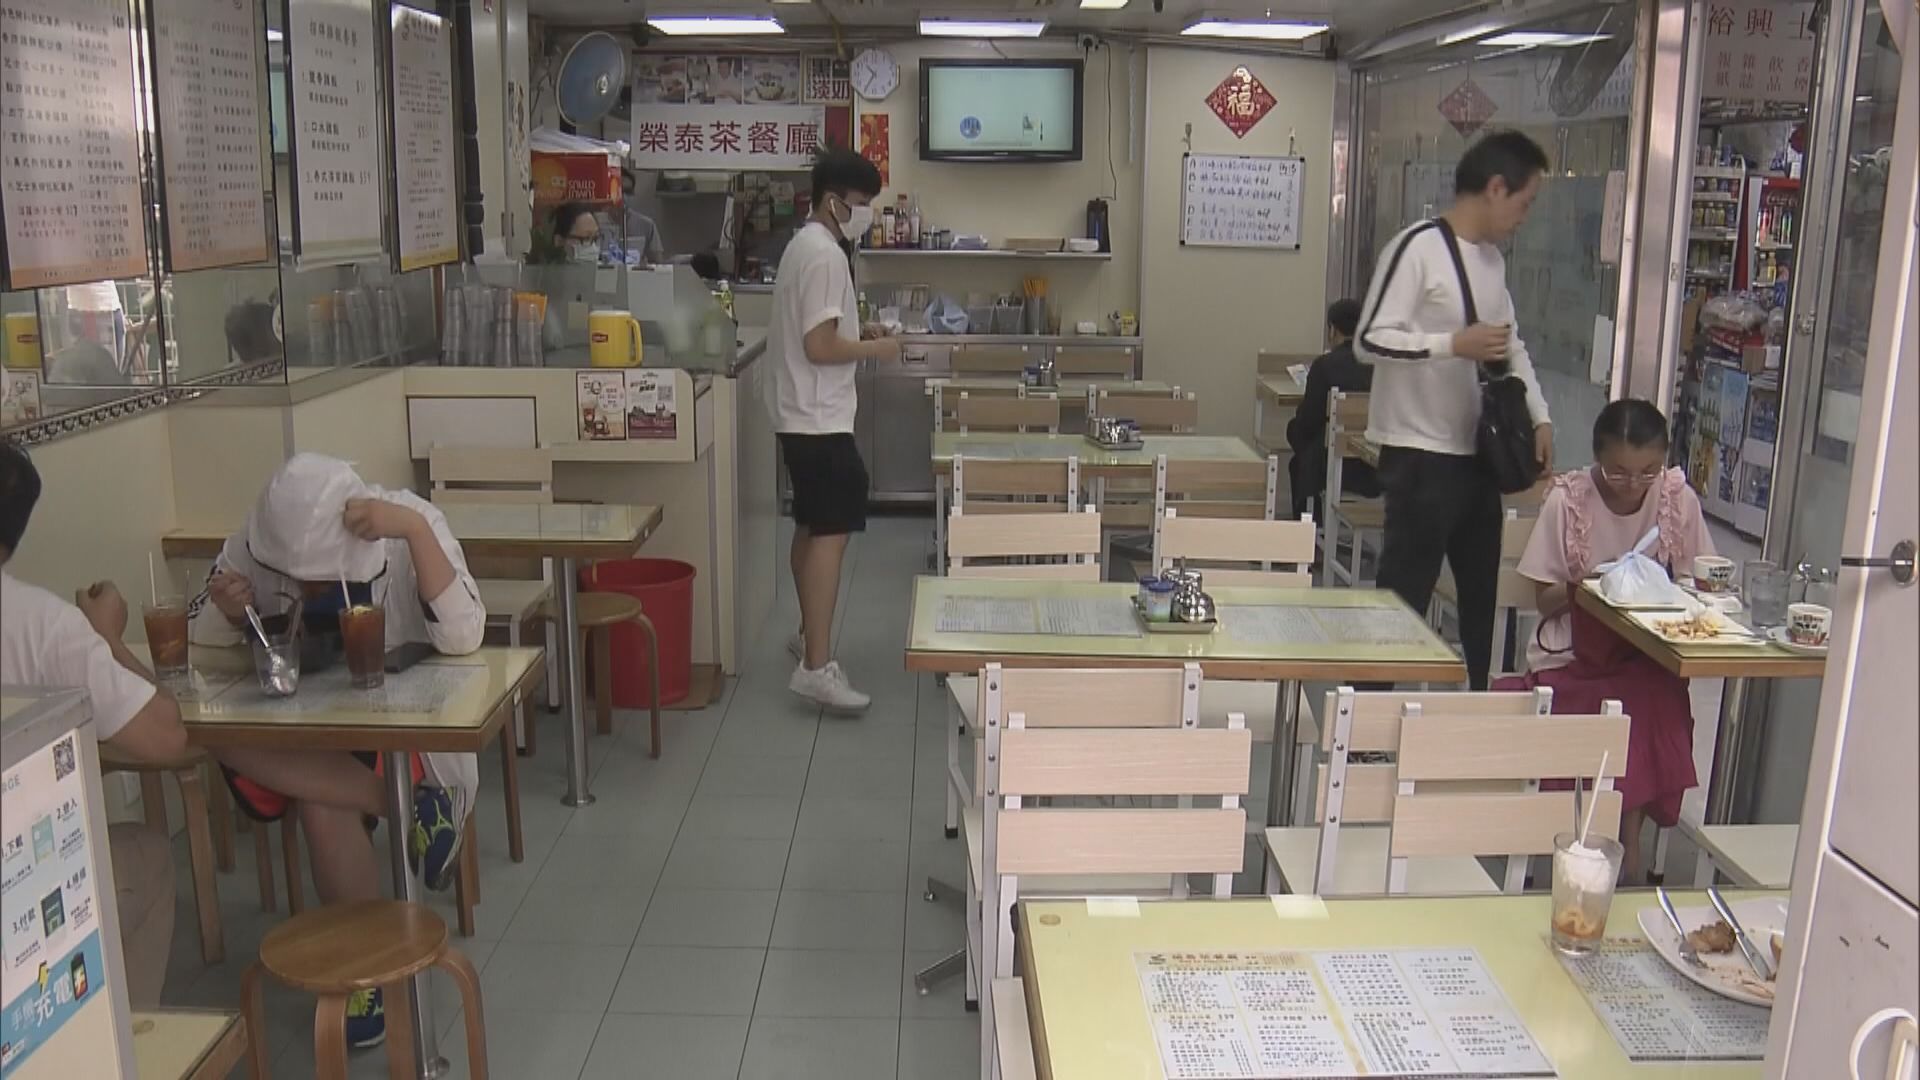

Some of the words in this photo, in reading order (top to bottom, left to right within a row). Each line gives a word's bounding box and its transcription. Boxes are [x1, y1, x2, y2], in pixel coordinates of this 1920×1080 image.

[1227, 82, 1255, 116] 福
[639, 121, 818, 156] 榮泰茶餐廳
